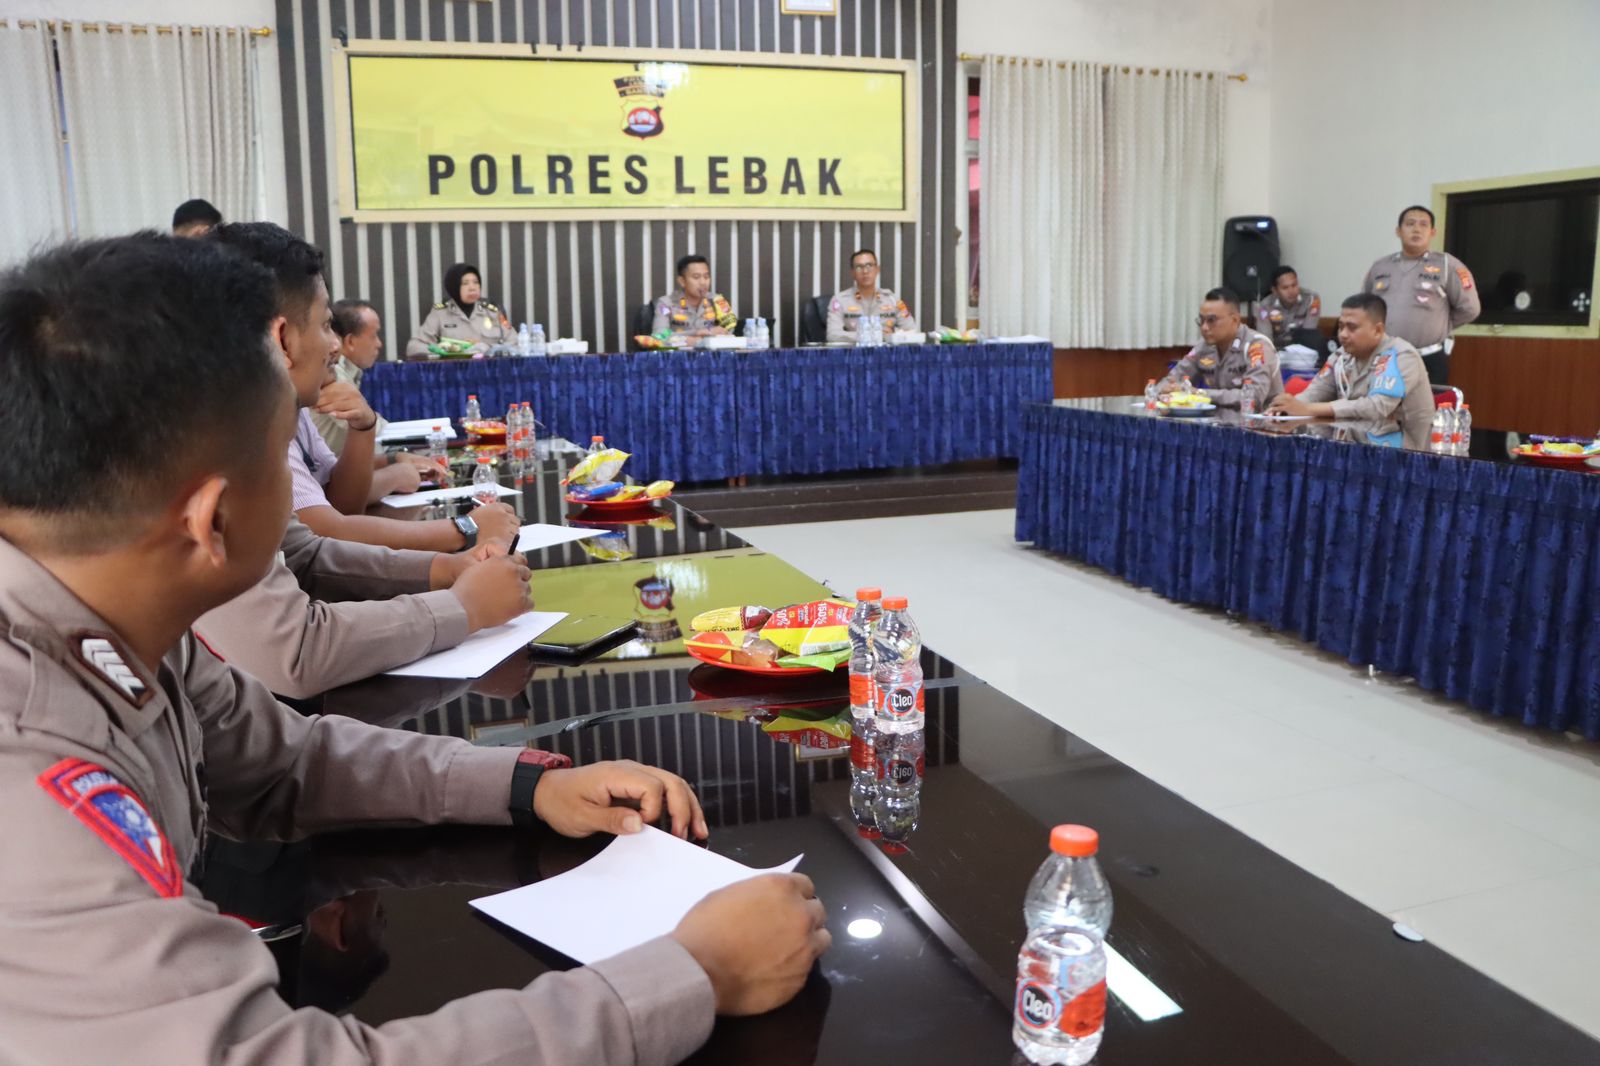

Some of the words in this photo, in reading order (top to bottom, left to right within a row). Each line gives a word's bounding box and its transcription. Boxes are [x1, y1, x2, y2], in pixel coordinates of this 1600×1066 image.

[427, 153, 649, 196] POLRES
[674, 155, 843, 197] LEBAK
[893, 694, 913, 708] Cleo
[1023, 989, 1053, 1020] Cleo
